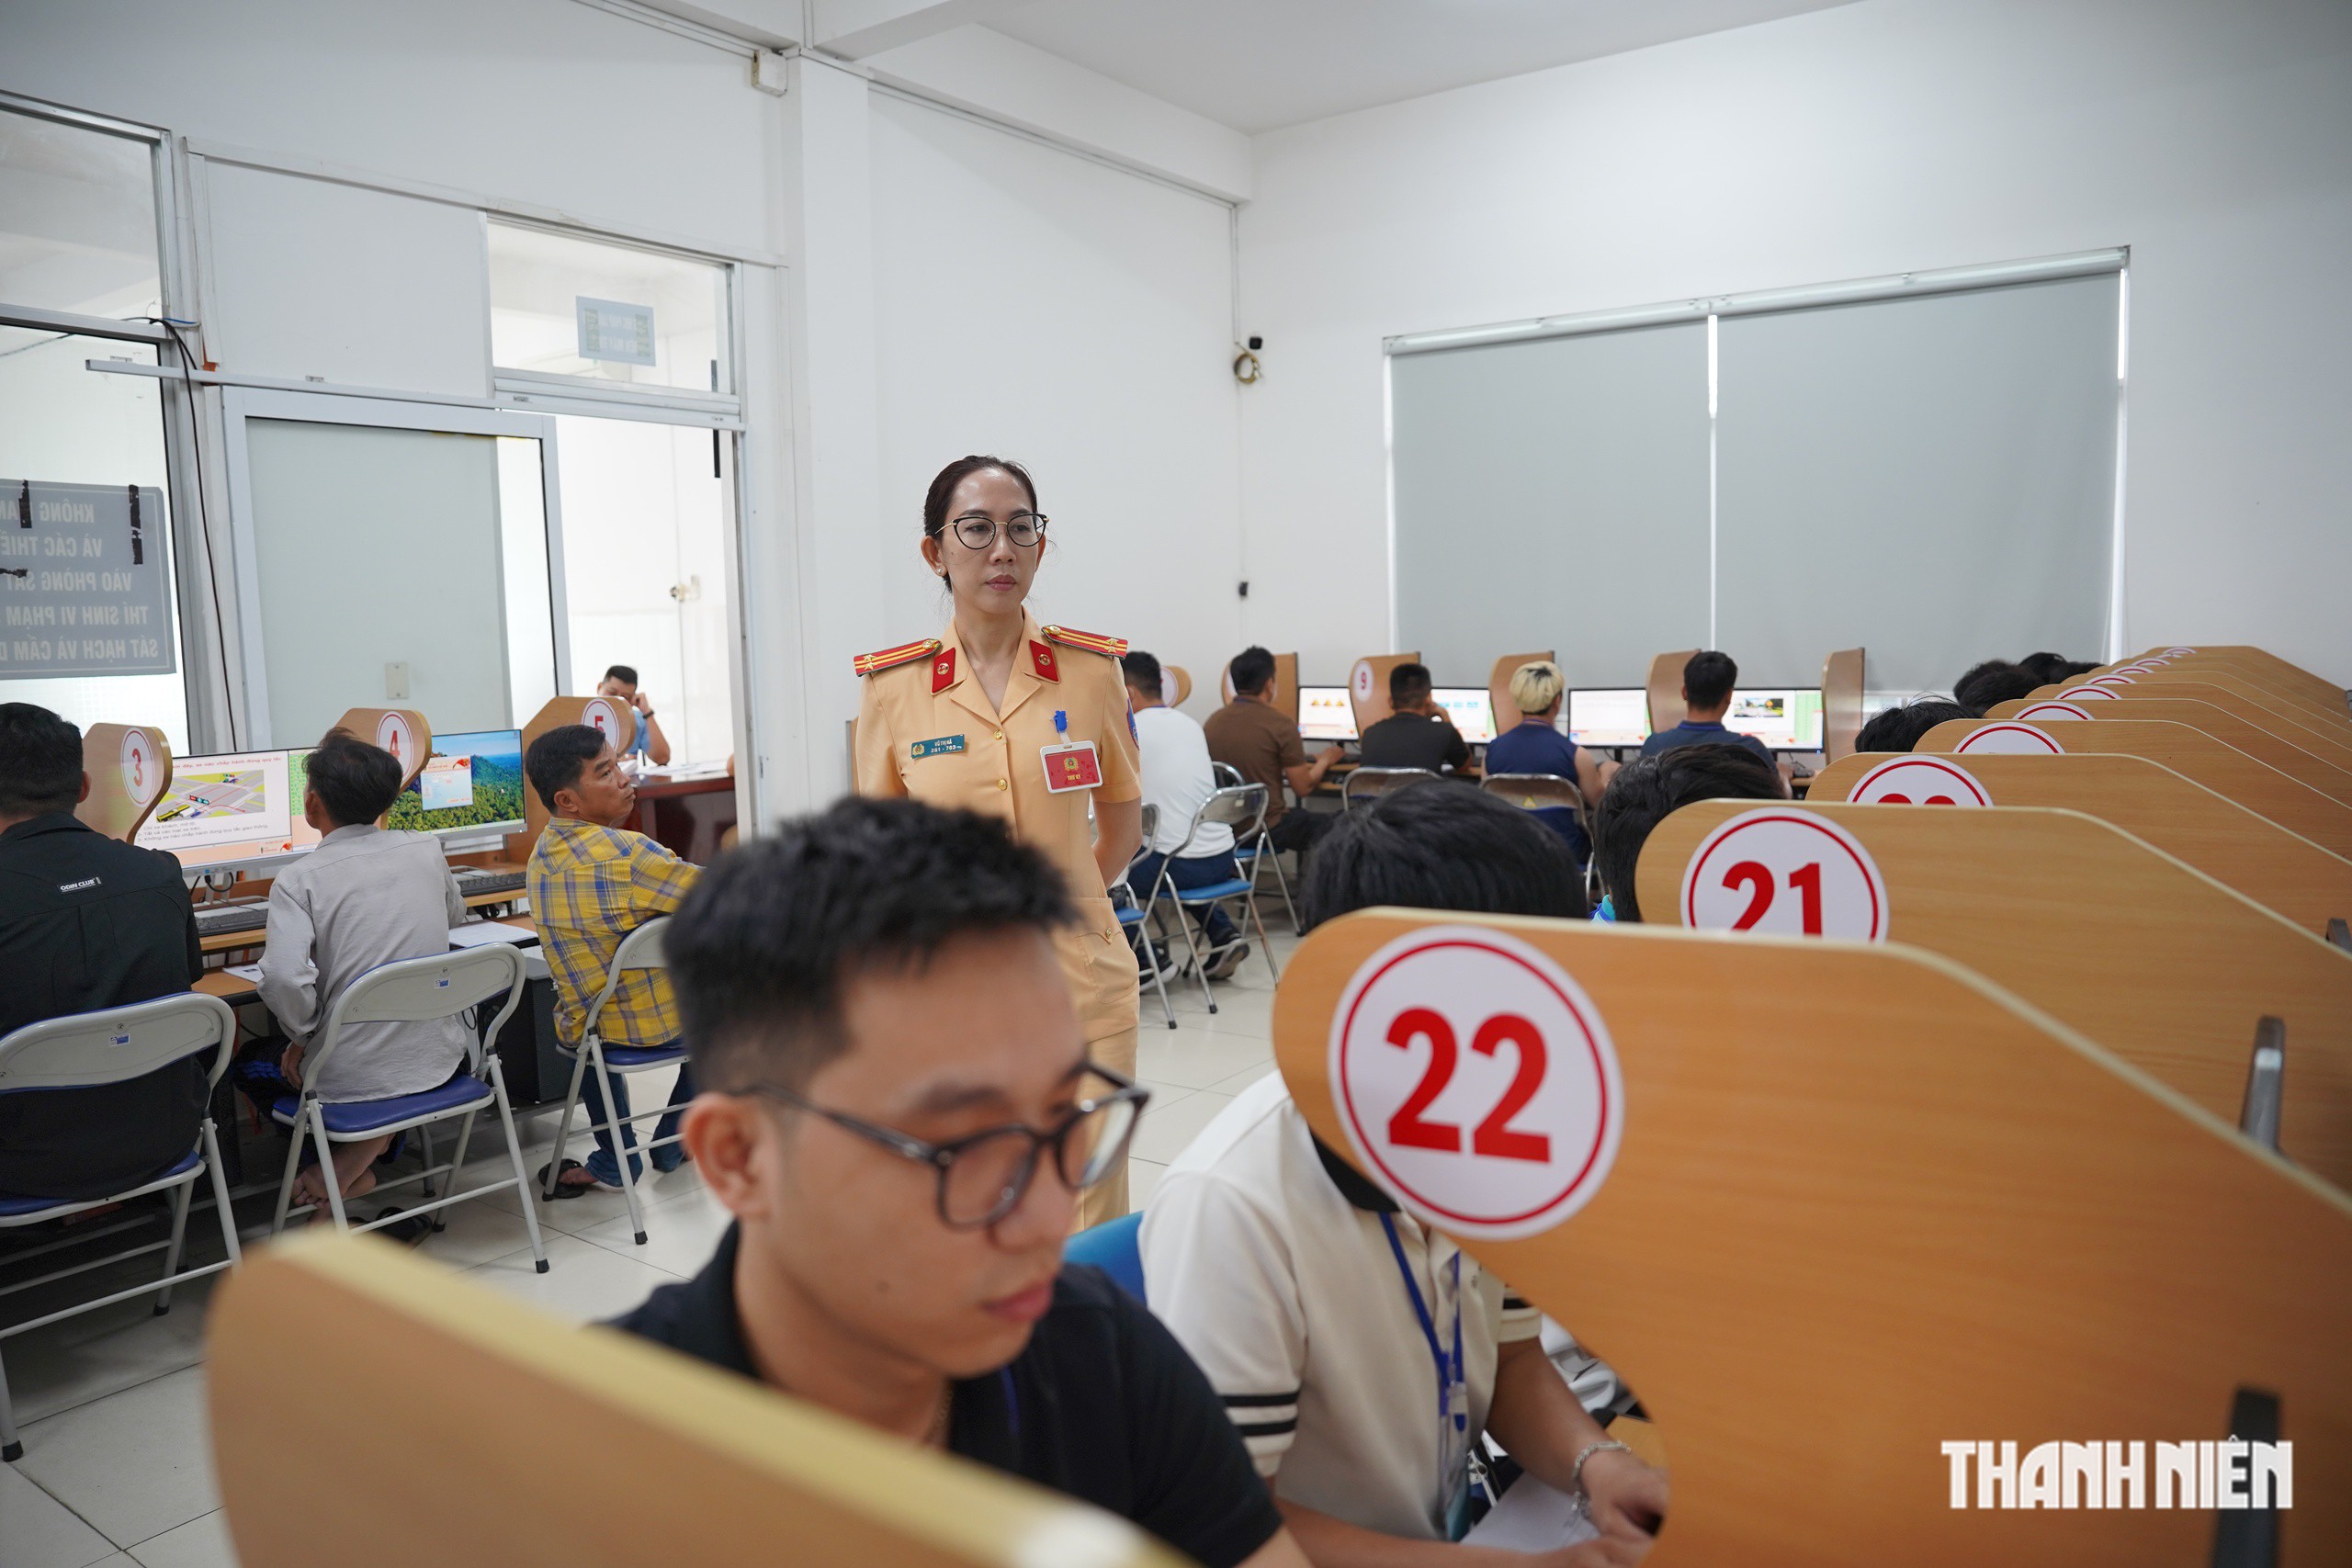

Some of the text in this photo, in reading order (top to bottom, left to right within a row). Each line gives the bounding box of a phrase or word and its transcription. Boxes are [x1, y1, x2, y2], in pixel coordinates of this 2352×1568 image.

[1360, 671, 1367, 689] 9
[390, 730, 401, 760] 4
[131, 748, 143, 787] 3
[1722, 861, 1822, 939] 21
[1385, 1007, 1551, 1163] 22
